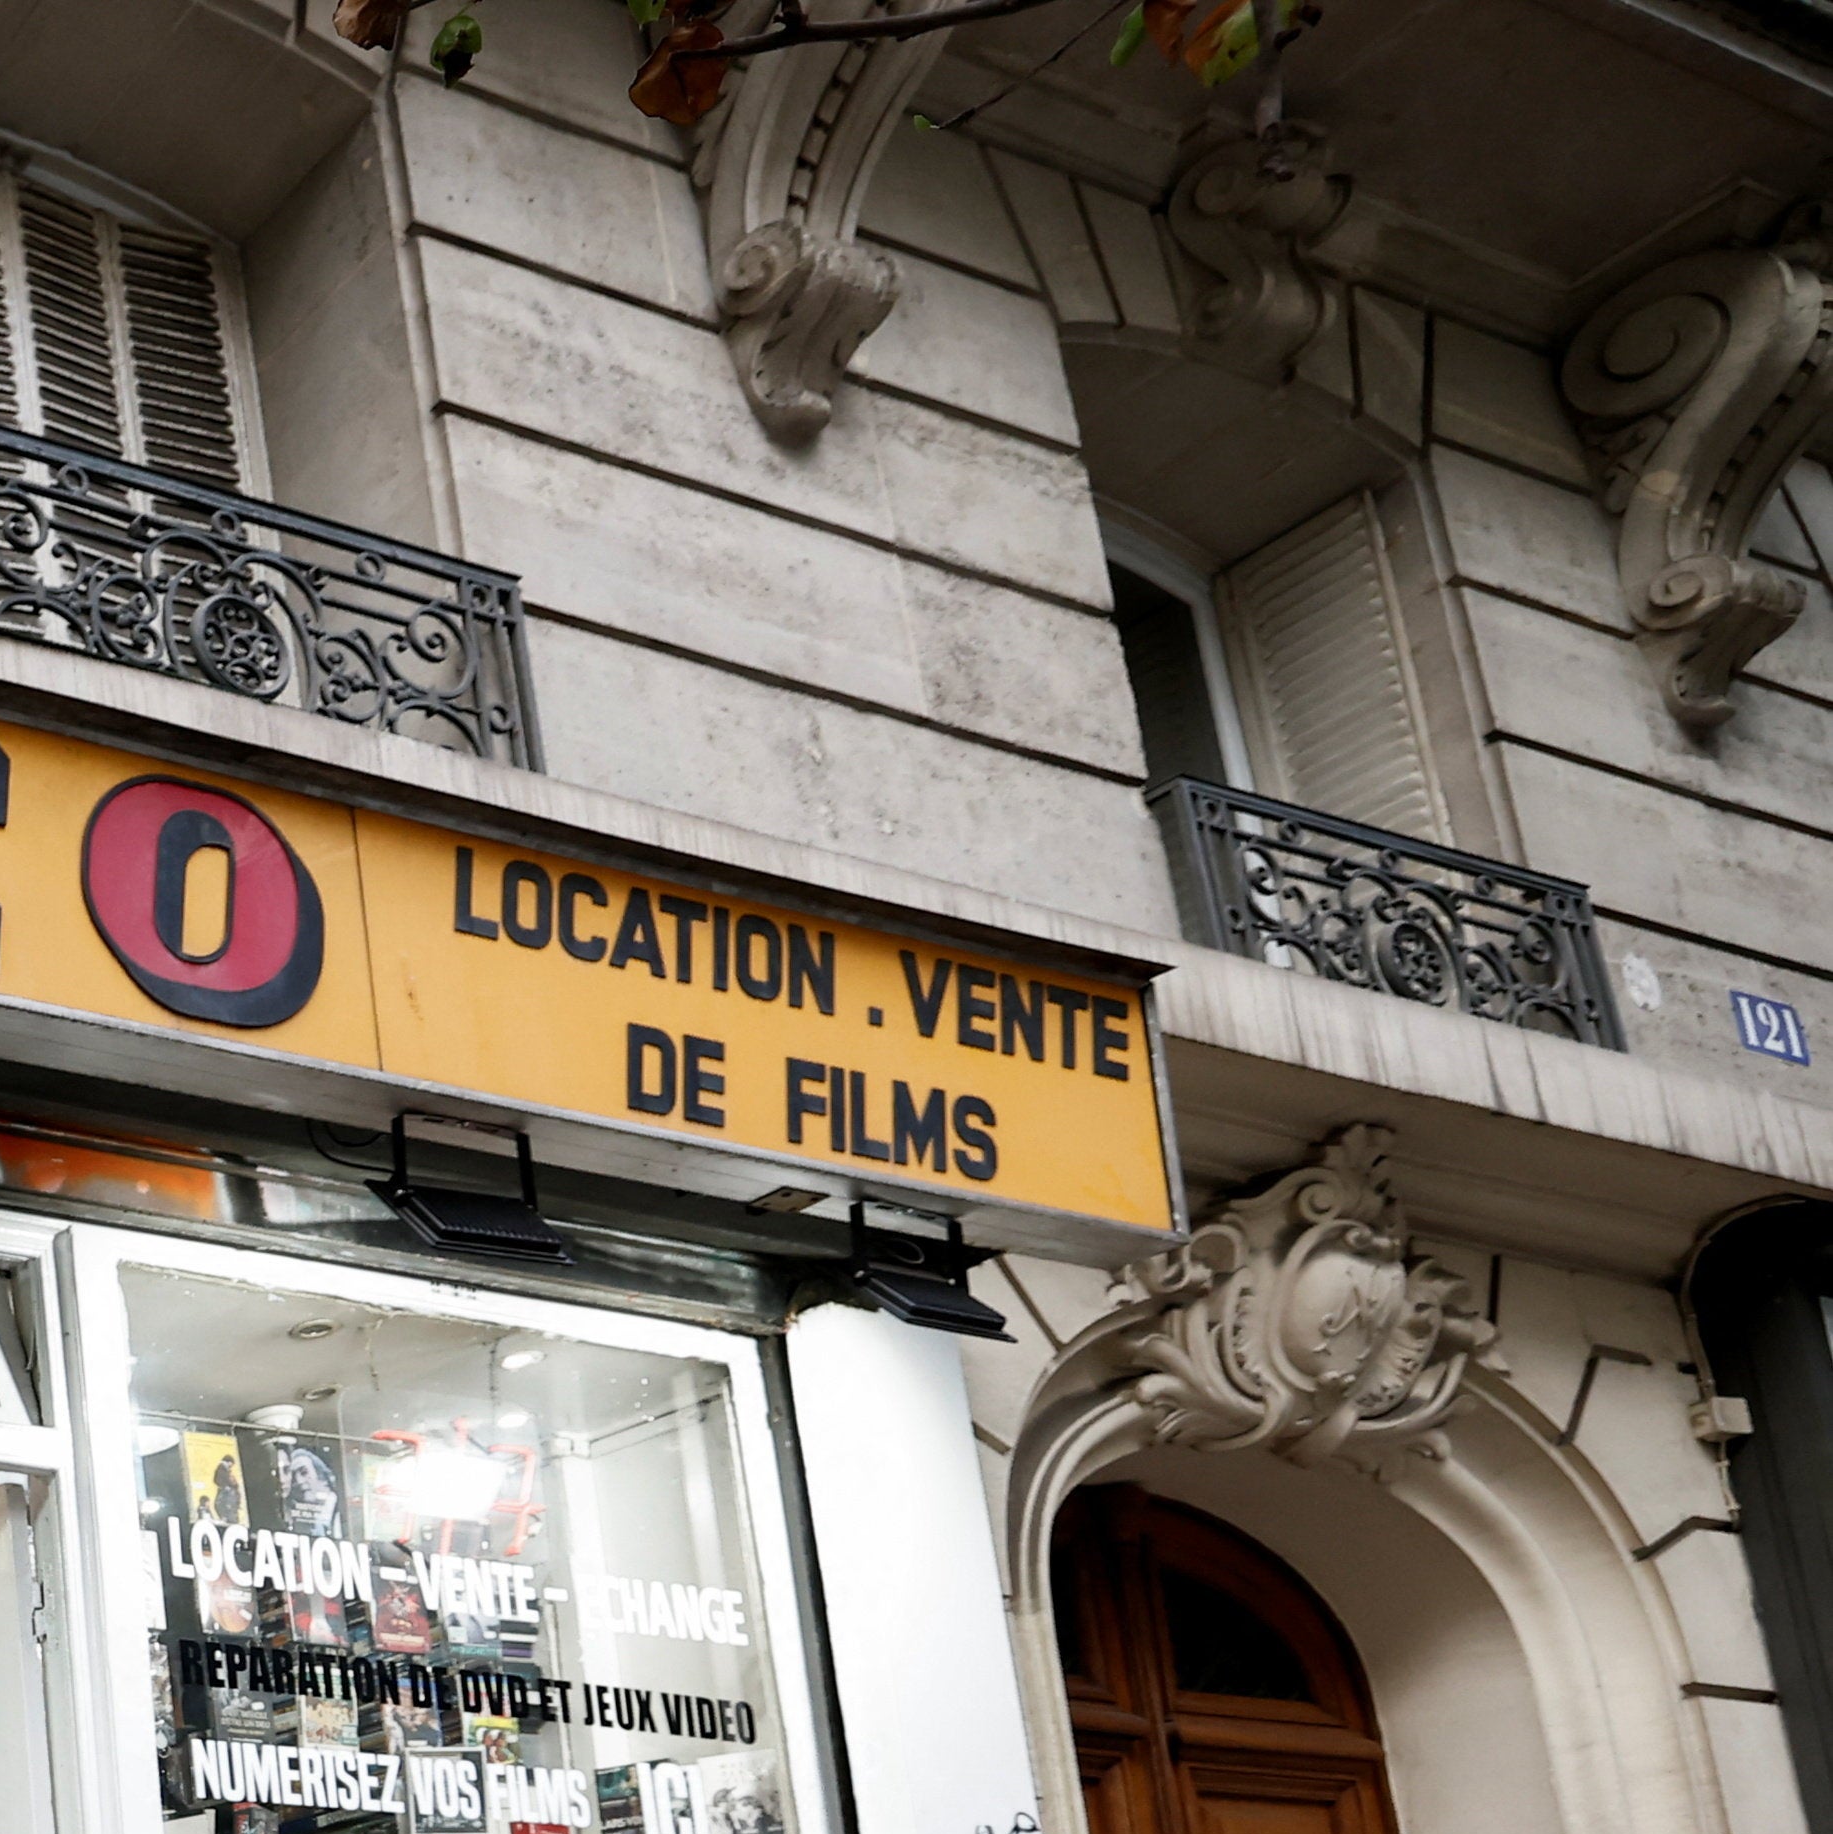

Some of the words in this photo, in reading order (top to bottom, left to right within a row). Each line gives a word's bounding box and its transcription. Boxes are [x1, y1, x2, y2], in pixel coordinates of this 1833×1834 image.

[454, 845, 836, 1020] LOCATION
[899, 949, 1133, 1081] VENTE
[1737, 997, 1806, 1061] 121
[626, 1023, 724, 1128] DE
[786, 1060, 1000, 1182] FILMS
[167, 1515, 373, 1602] LOCATION
[413, 1550, 541, 1624] VENTE
[179, 1638, 401, 1706] REPARATION
[411, 1663, 452, 1711] DE
[459, 1668, 533, 1720] DVD
[537, 1678, 573, 1724] ET
[583, 1682, 658, 1734] JEUX
[660, 1692, 757, 1745] VIDEO
[190, 1738, 407, 1815] NUMERISEZ
[409, 1751, 486, 1820] VOS
[486, 1762, 593, 1830] FILMS
